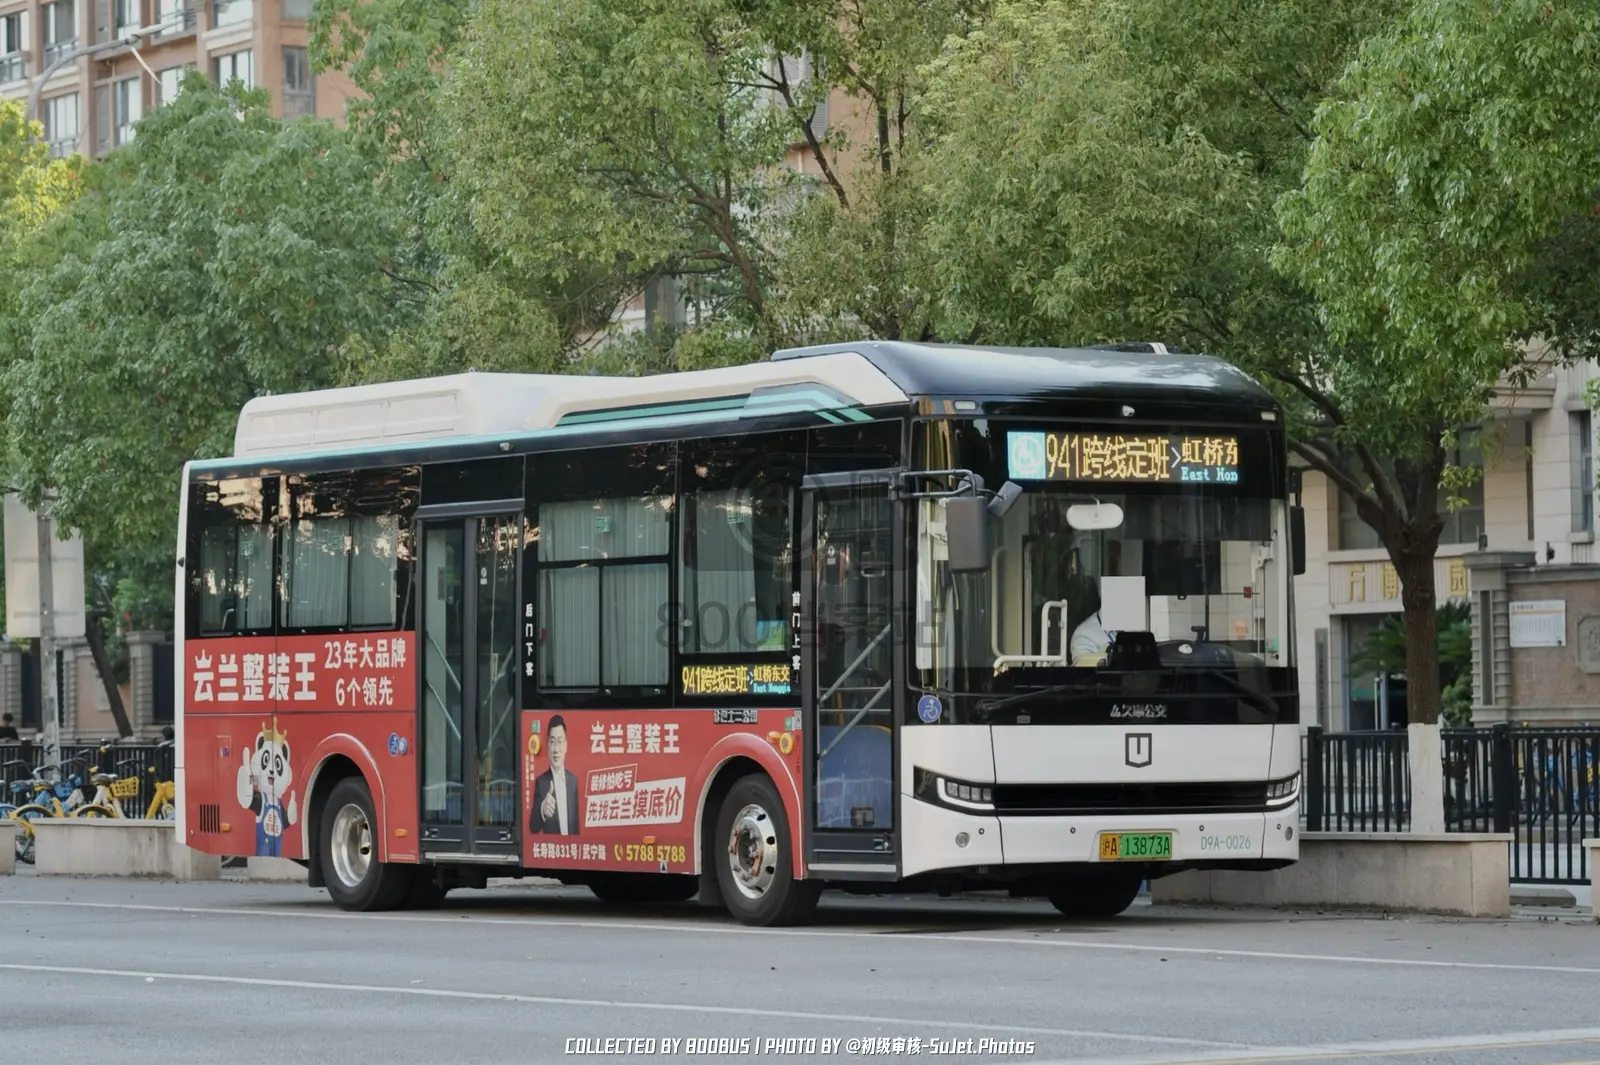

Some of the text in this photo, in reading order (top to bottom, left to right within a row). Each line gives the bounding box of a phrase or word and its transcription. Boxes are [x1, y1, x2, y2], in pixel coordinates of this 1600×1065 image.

[1046, 434, 1169, 480] 941跨线定班
[1181, 466, 1238, 482] East Hon
[526, 602, 534, 677] 后门下客
[792, 591, 801, 670] 前门上客
[324, 637, 407, 669] 23年大品牌
[193, 649, 317, 702] 云兰整装王
[335, 676, 394, 706] 6个领先
[682, 664, 790, 694] 941跨线定班 虹桥东交
[590, 721, 680, 754] 云兰整装王
[590, 769, 633, 792] 装修怕吃亏
[588, 785, 682, 821] 先找云兰摸底价
[626, 844, 686, 862] 5788 5788
[1125, 835, 1170, 856] 13873A
[1200, 834, 1252, 851] D9A-0026
